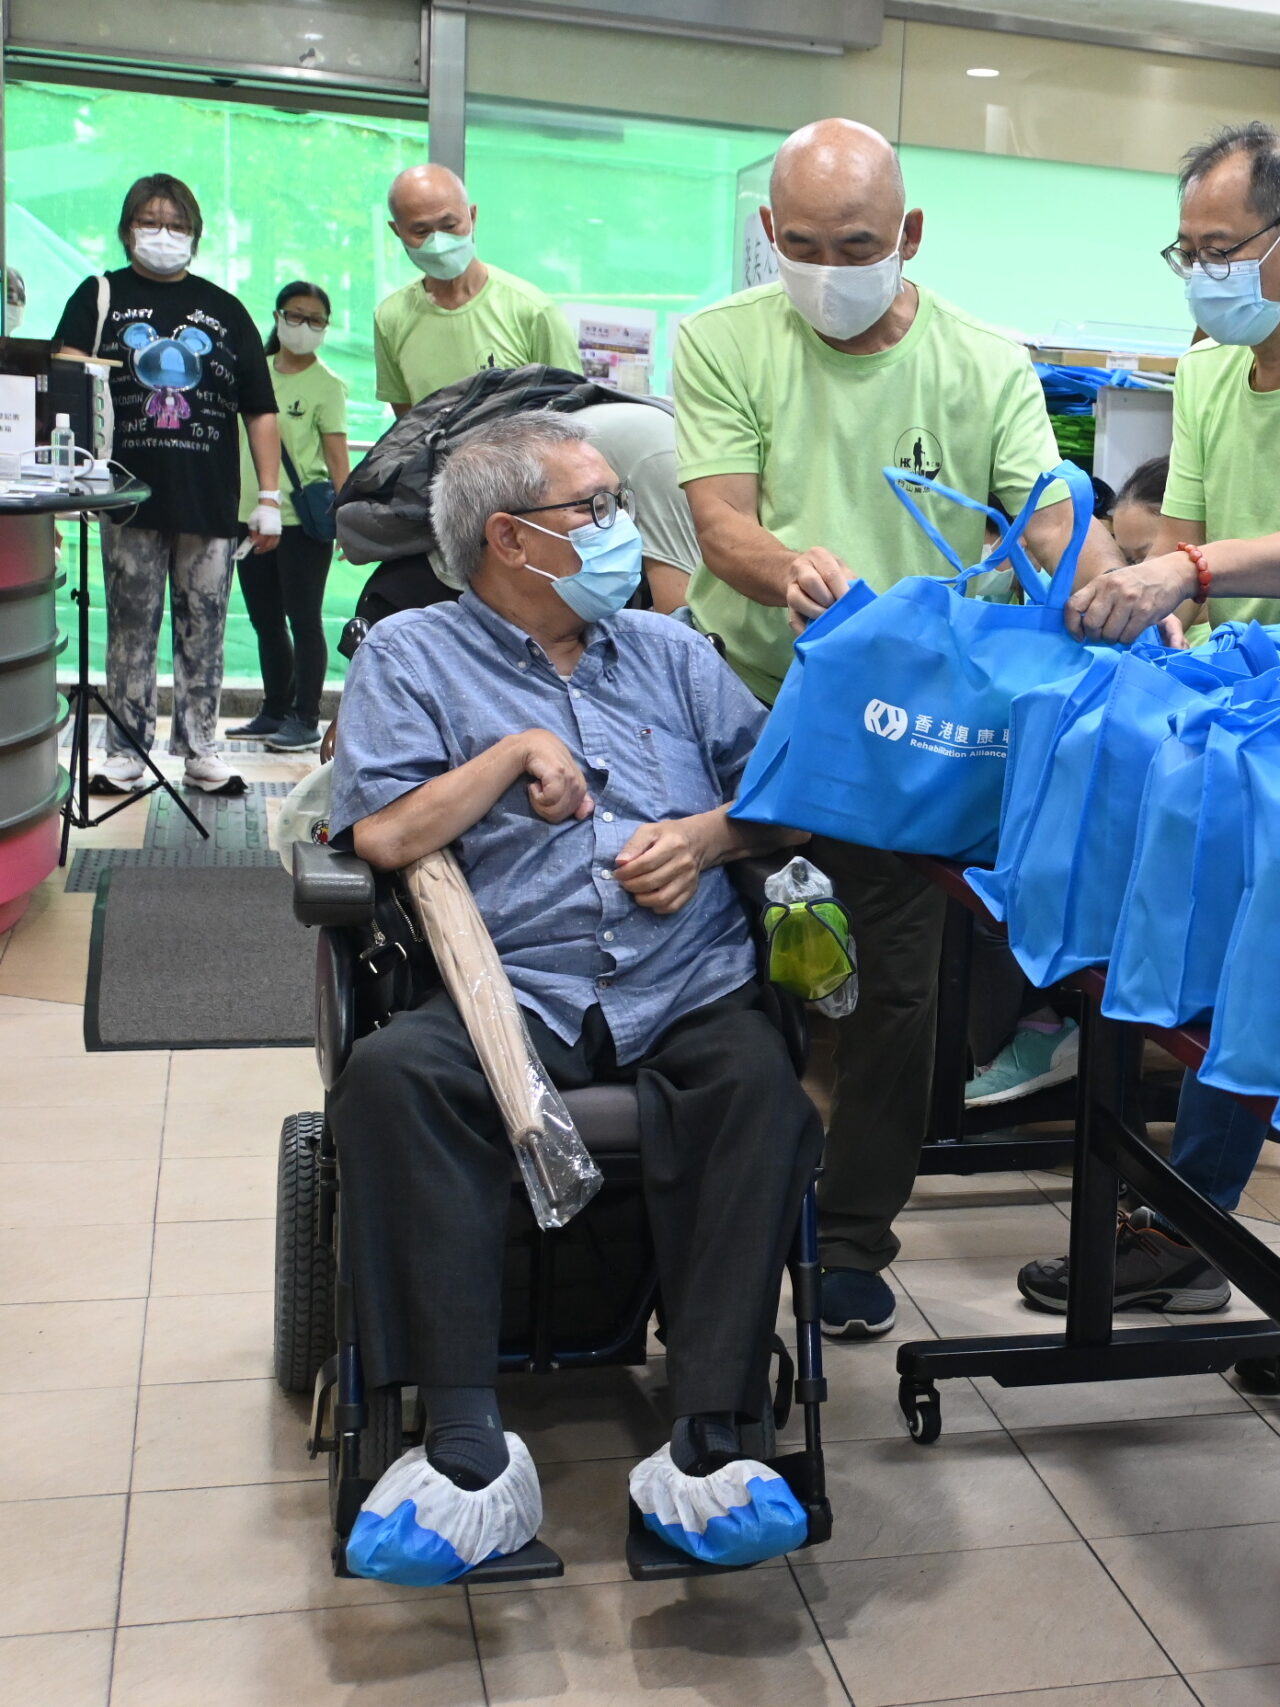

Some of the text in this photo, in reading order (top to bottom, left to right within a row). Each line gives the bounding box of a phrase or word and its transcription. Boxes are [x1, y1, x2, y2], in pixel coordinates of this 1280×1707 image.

[900, 457, 911, 469] HK
[910, 738, 1007, 759] Rehabilitation Alliance
